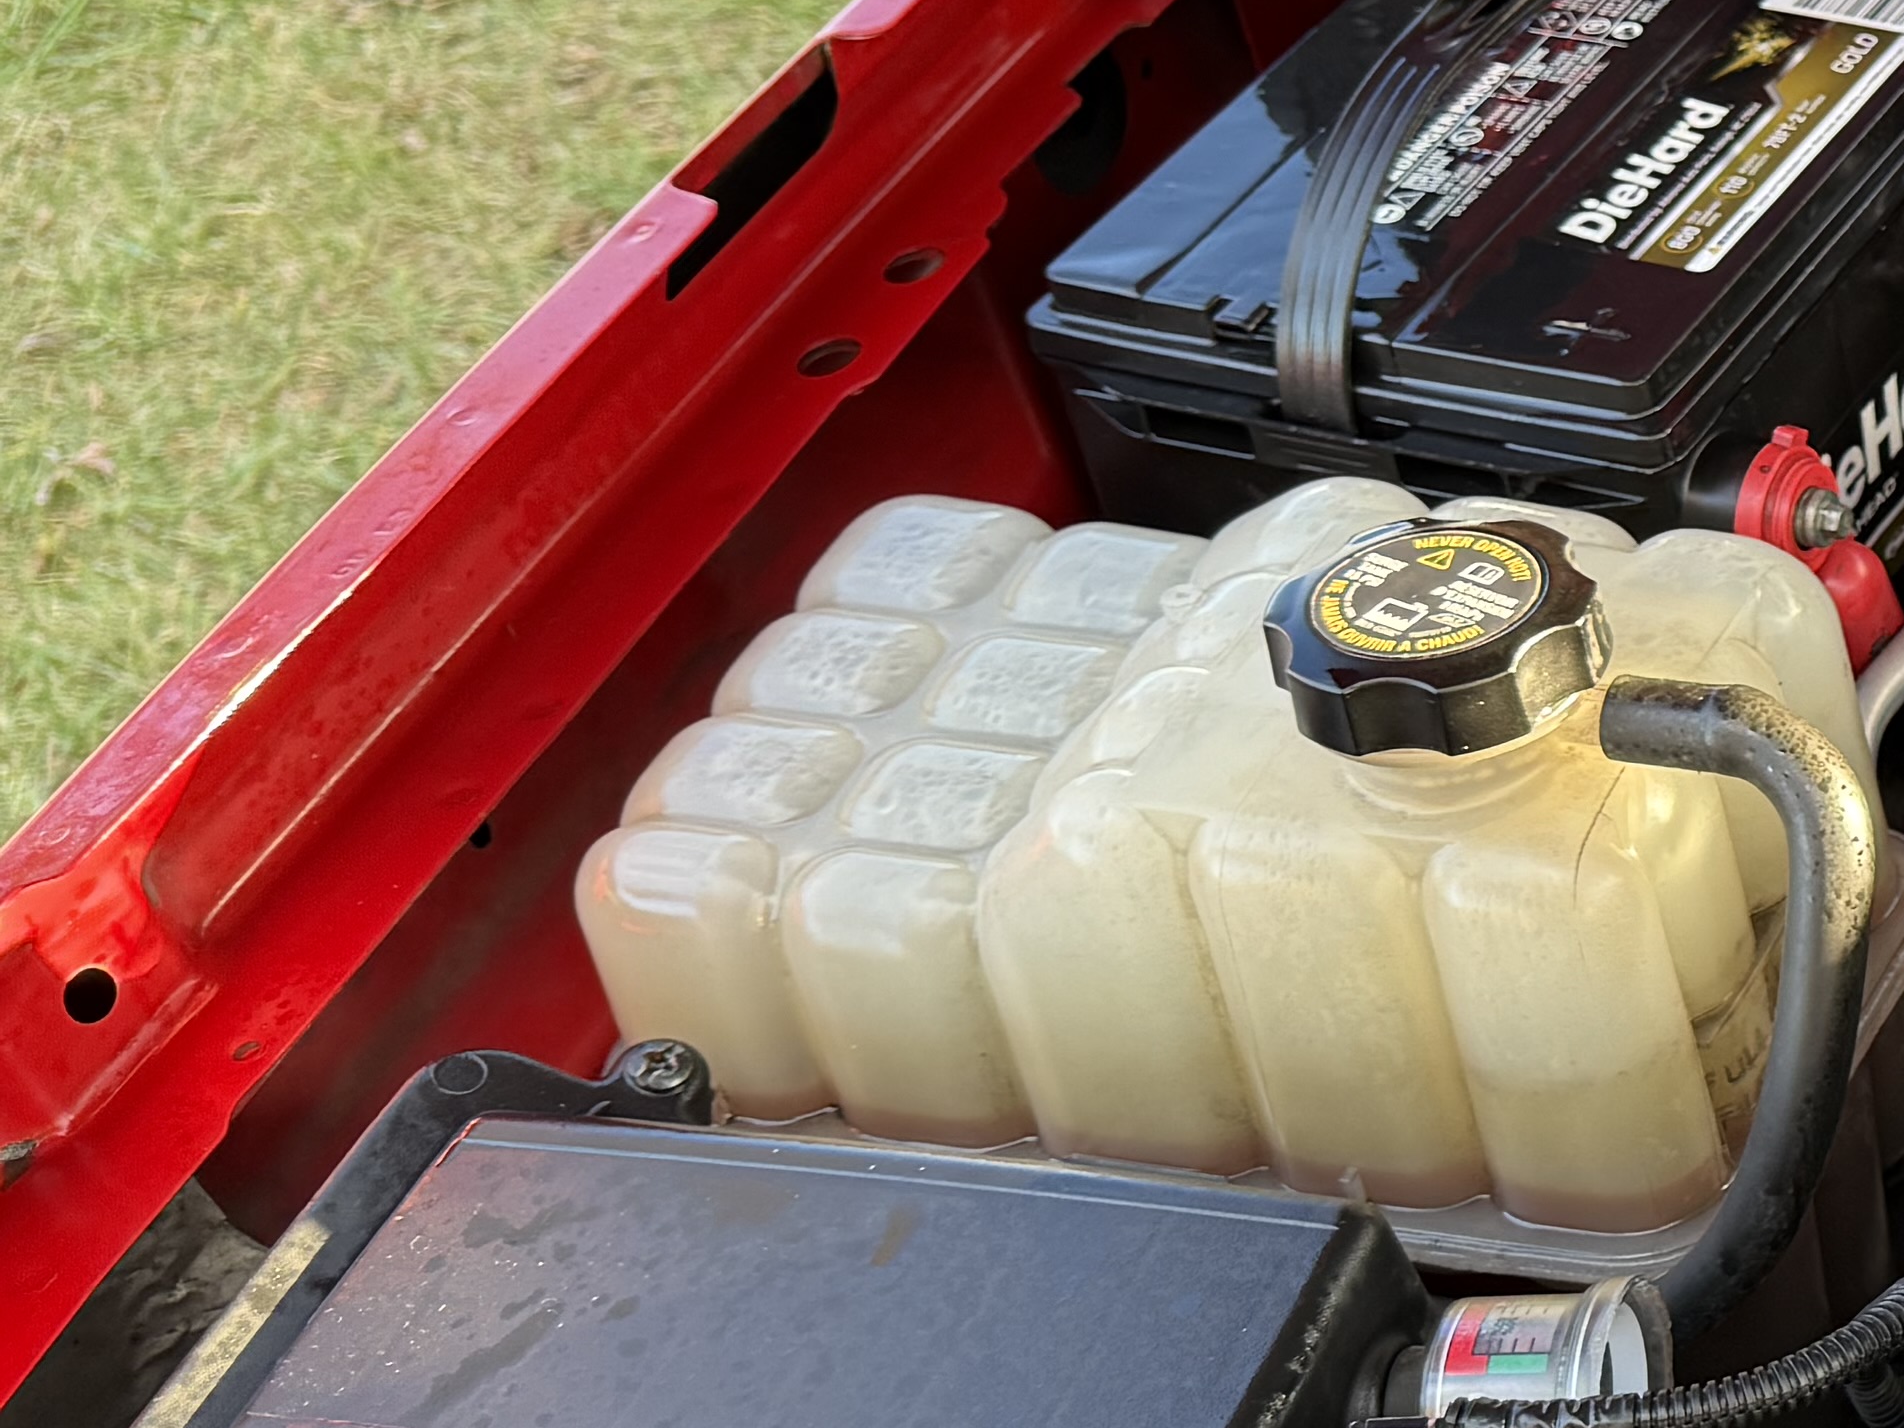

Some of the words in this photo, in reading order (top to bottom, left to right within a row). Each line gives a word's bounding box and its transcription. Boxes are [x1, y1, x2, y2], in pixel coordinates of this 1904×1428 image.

[1829, 32, 1880, 74] GOLD
[1558, 97, 1731, 244] DieHard
[1414, 535, 1475, 551] NEVER
[1476, 538, 1515, 563] OPEN
[1415, 623, 1486, 652] CHAUD!
